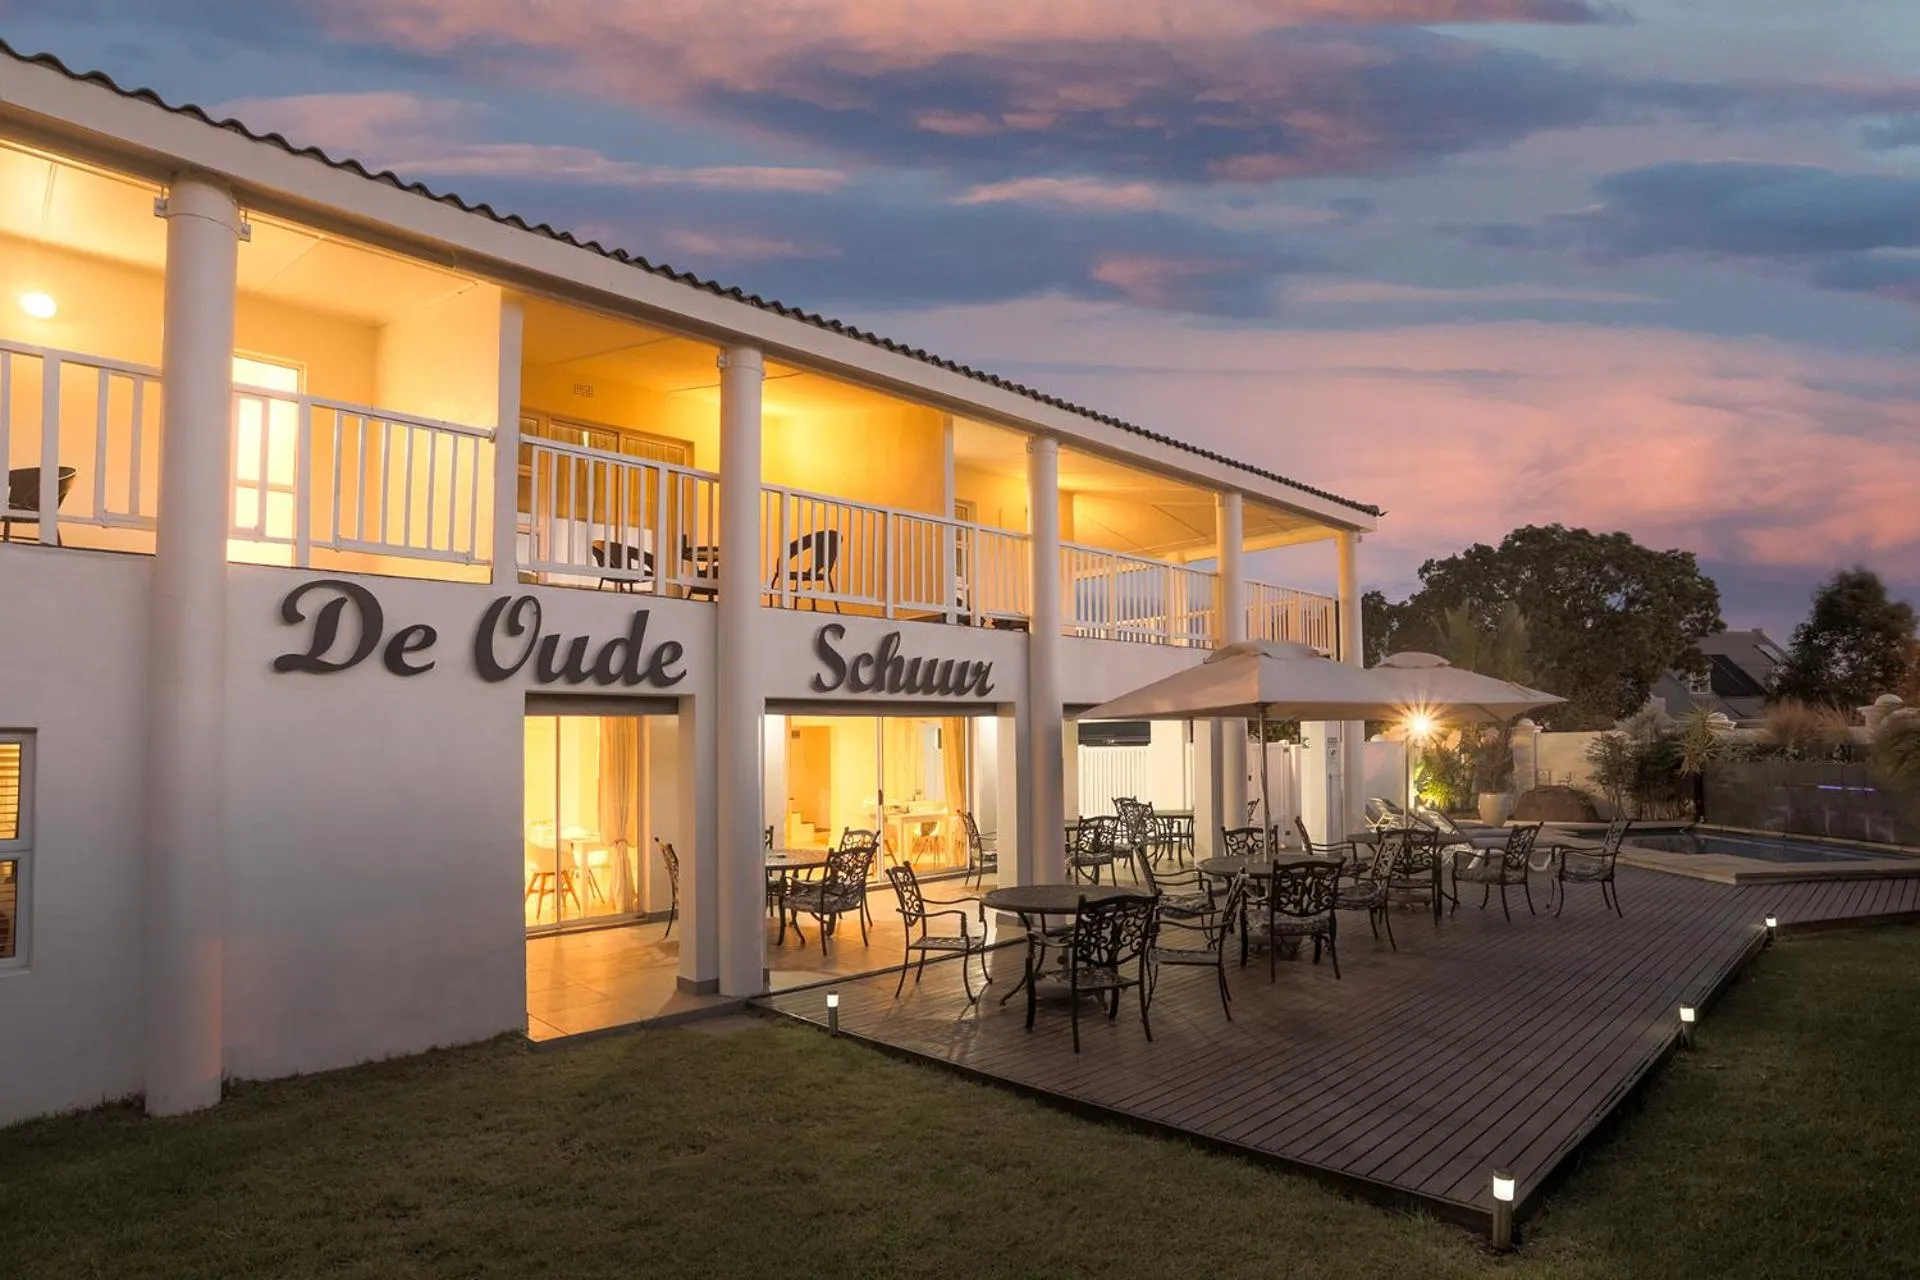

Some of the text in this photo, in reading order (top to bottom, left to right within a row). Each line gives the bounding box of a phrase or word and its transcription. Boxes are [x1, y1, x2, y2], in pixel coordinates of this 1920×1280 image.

[273, 579, 995, 697] De Oude Schuur
